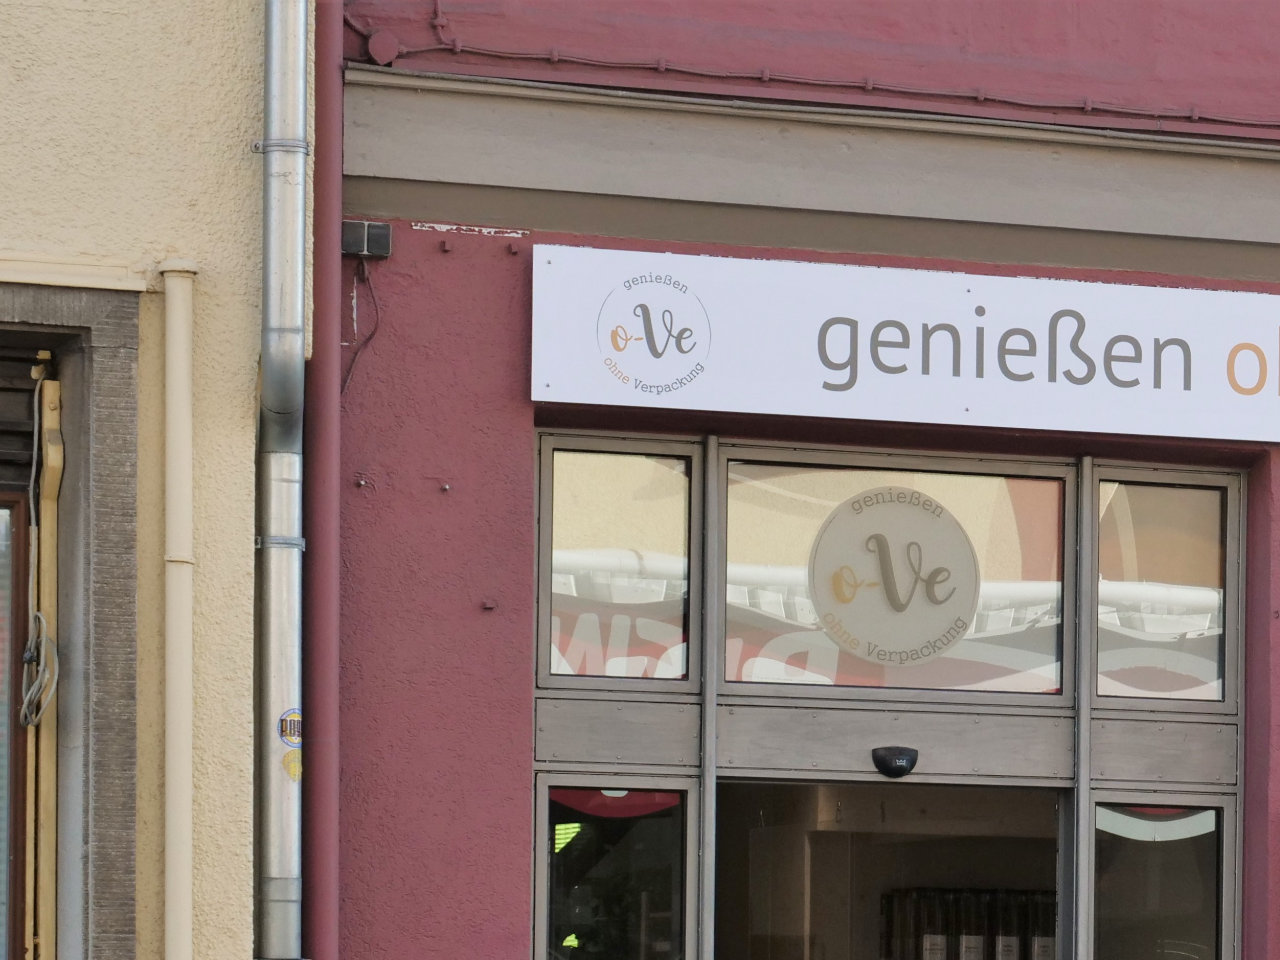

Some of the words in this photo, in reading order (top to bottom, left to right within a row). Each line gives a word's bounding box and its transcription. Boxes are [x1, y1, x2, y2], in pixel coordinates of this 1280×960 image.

[623, 272, 689, 294] genießen
[817, 305, 1193, 392] genießen
[603, 357, 630, 384] ohne
[633, 362, 705, 395] Verpackung
[851, 488, 945, 518] genießen
[823, 612, 861, 650] ohne
[866, 616, 968, 665] Verpackung
